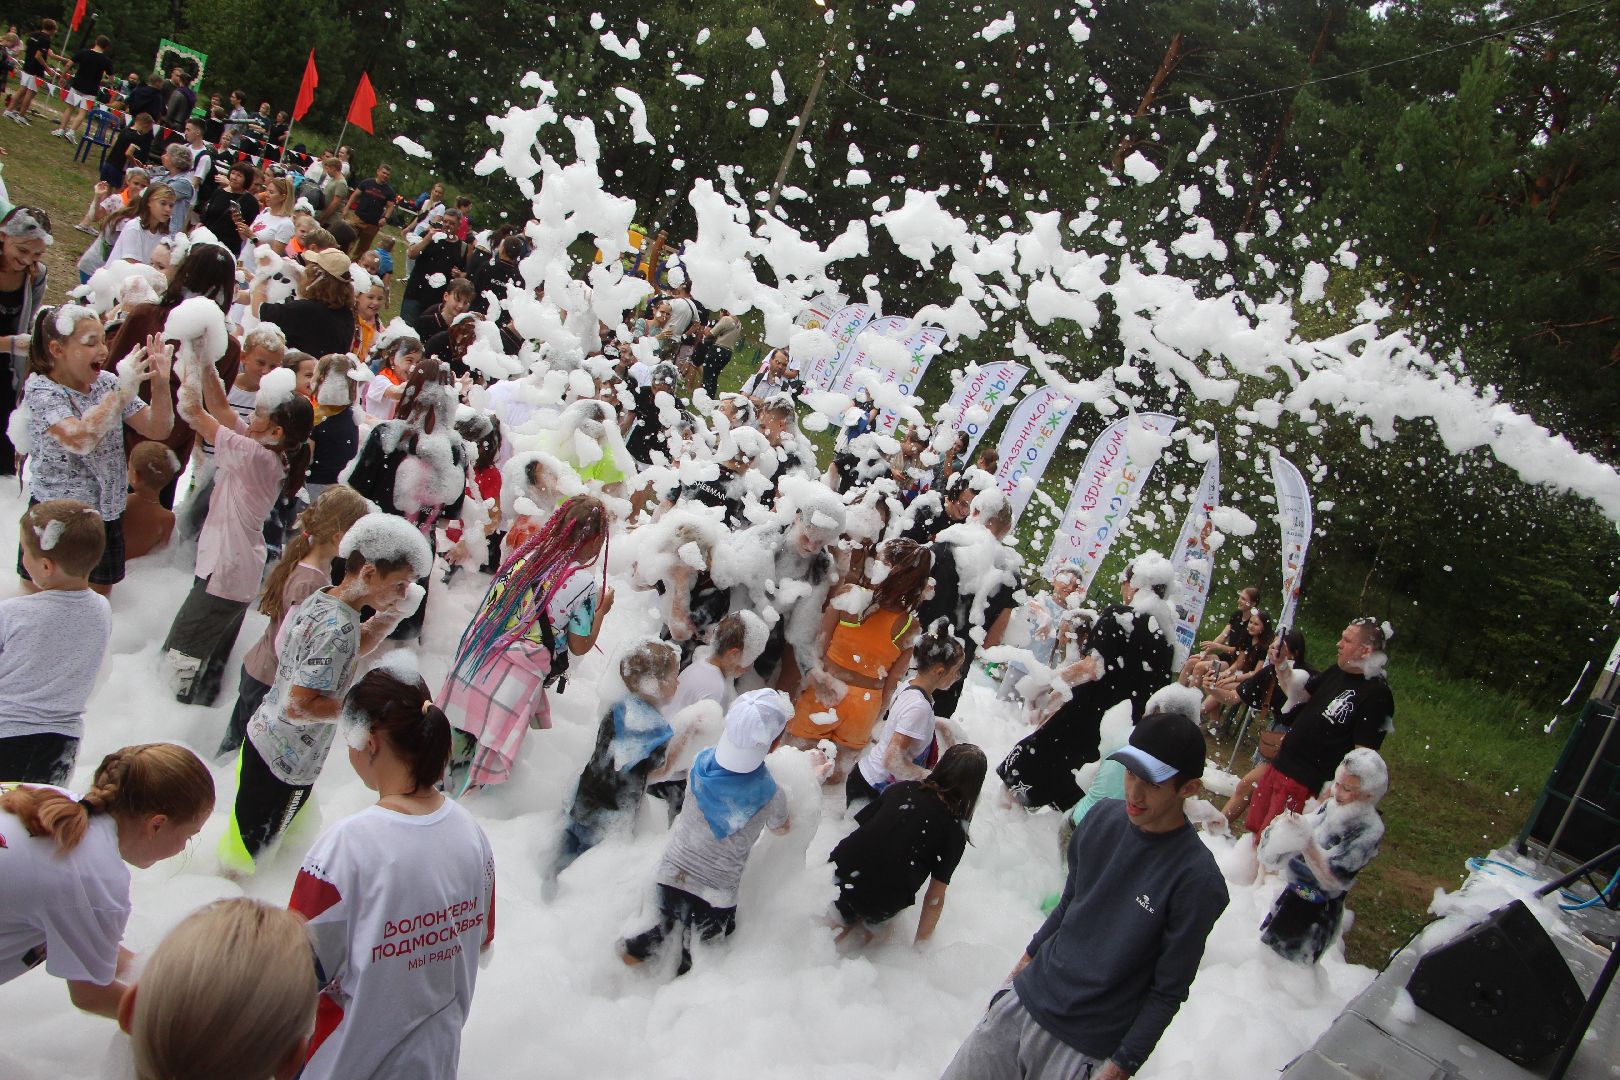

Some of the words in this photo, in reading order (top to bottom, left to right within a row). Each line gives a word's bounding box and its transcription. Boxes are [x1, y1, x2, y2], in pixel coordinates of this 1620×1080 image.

[1075, 429, 1127, 532] ПАЗДНИКОМ,
[1070, 534, 1082, 548] С
[372, 913, 484, 963] ПОДМОСКОВЬЯ
[383, 897, 478, 940] ВОЛОНТЕРЫ
[408, 955, 426, 971] МЫ
